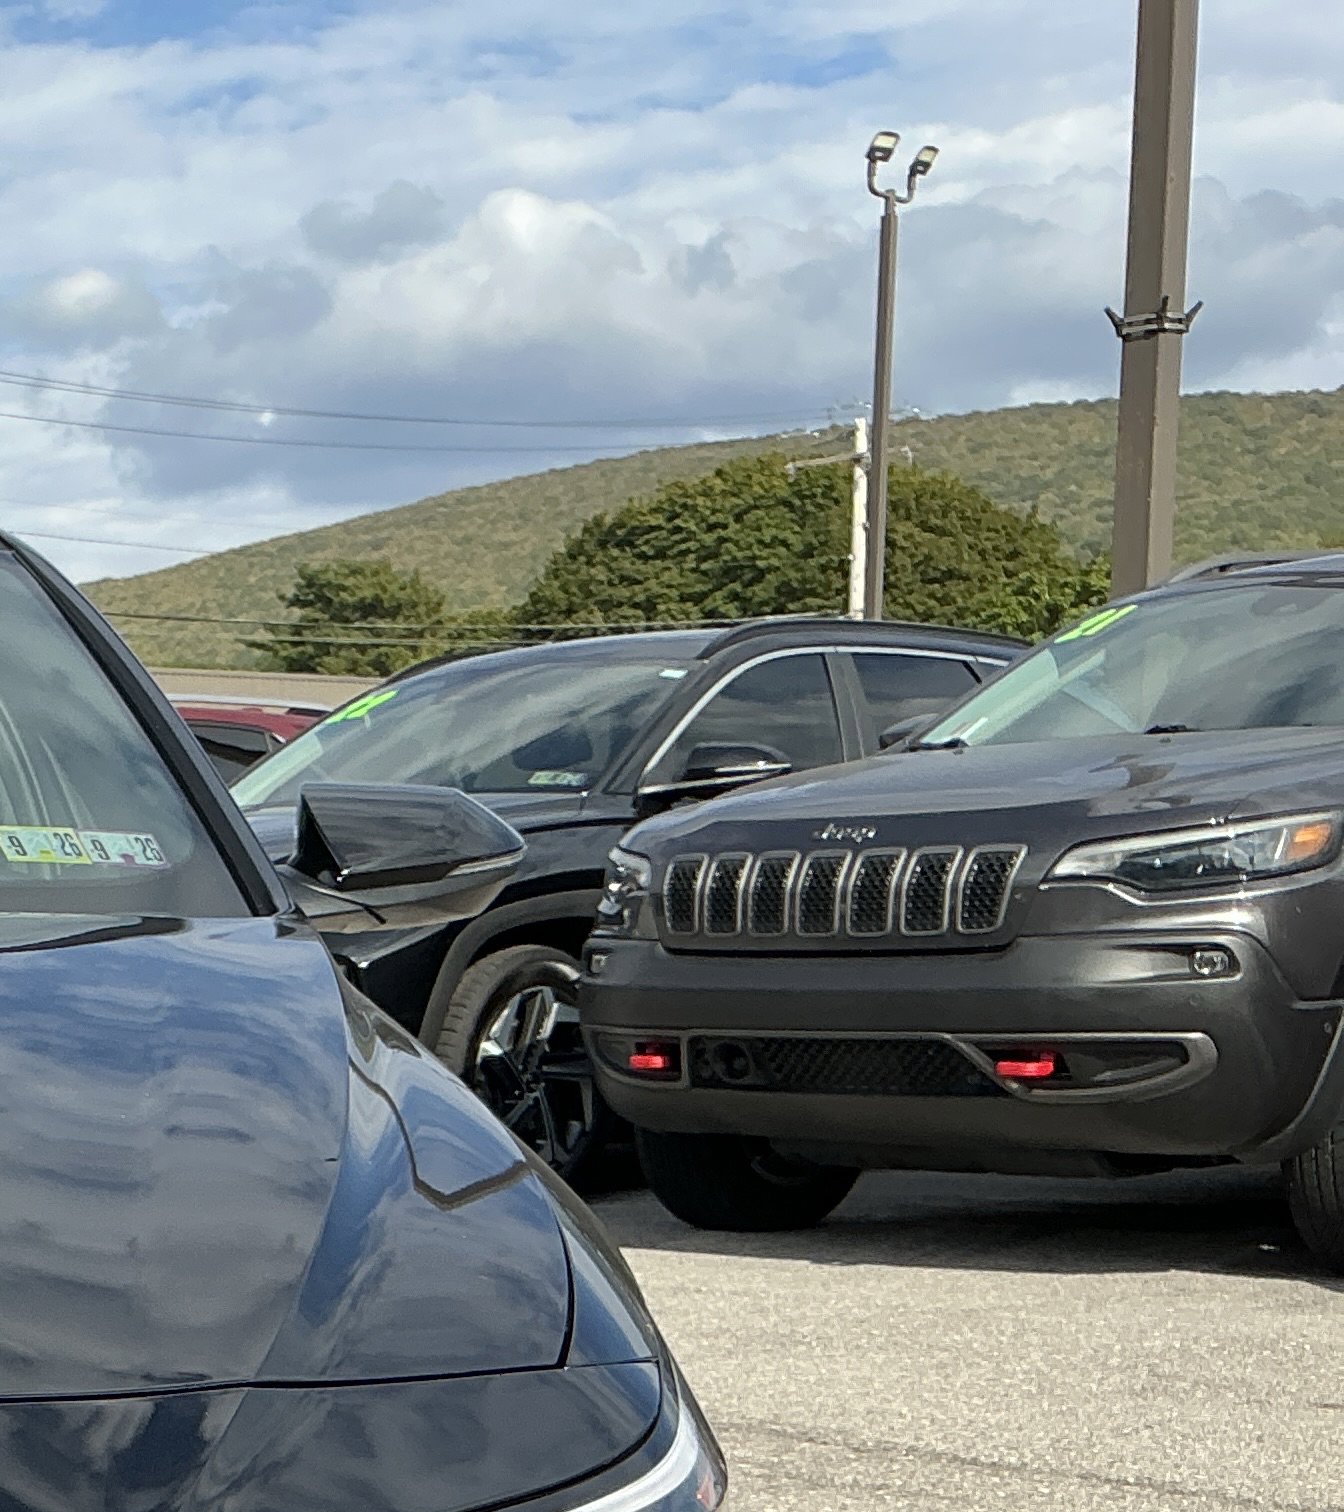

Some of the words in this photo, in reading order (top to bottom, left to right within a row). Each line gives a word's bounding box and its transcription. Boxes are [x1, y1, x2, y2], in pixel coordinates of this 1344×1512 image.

[7, 835, 28, 857] 9
[52, 832, 84, 858] 26
[90, 838, 111, 861] 9
